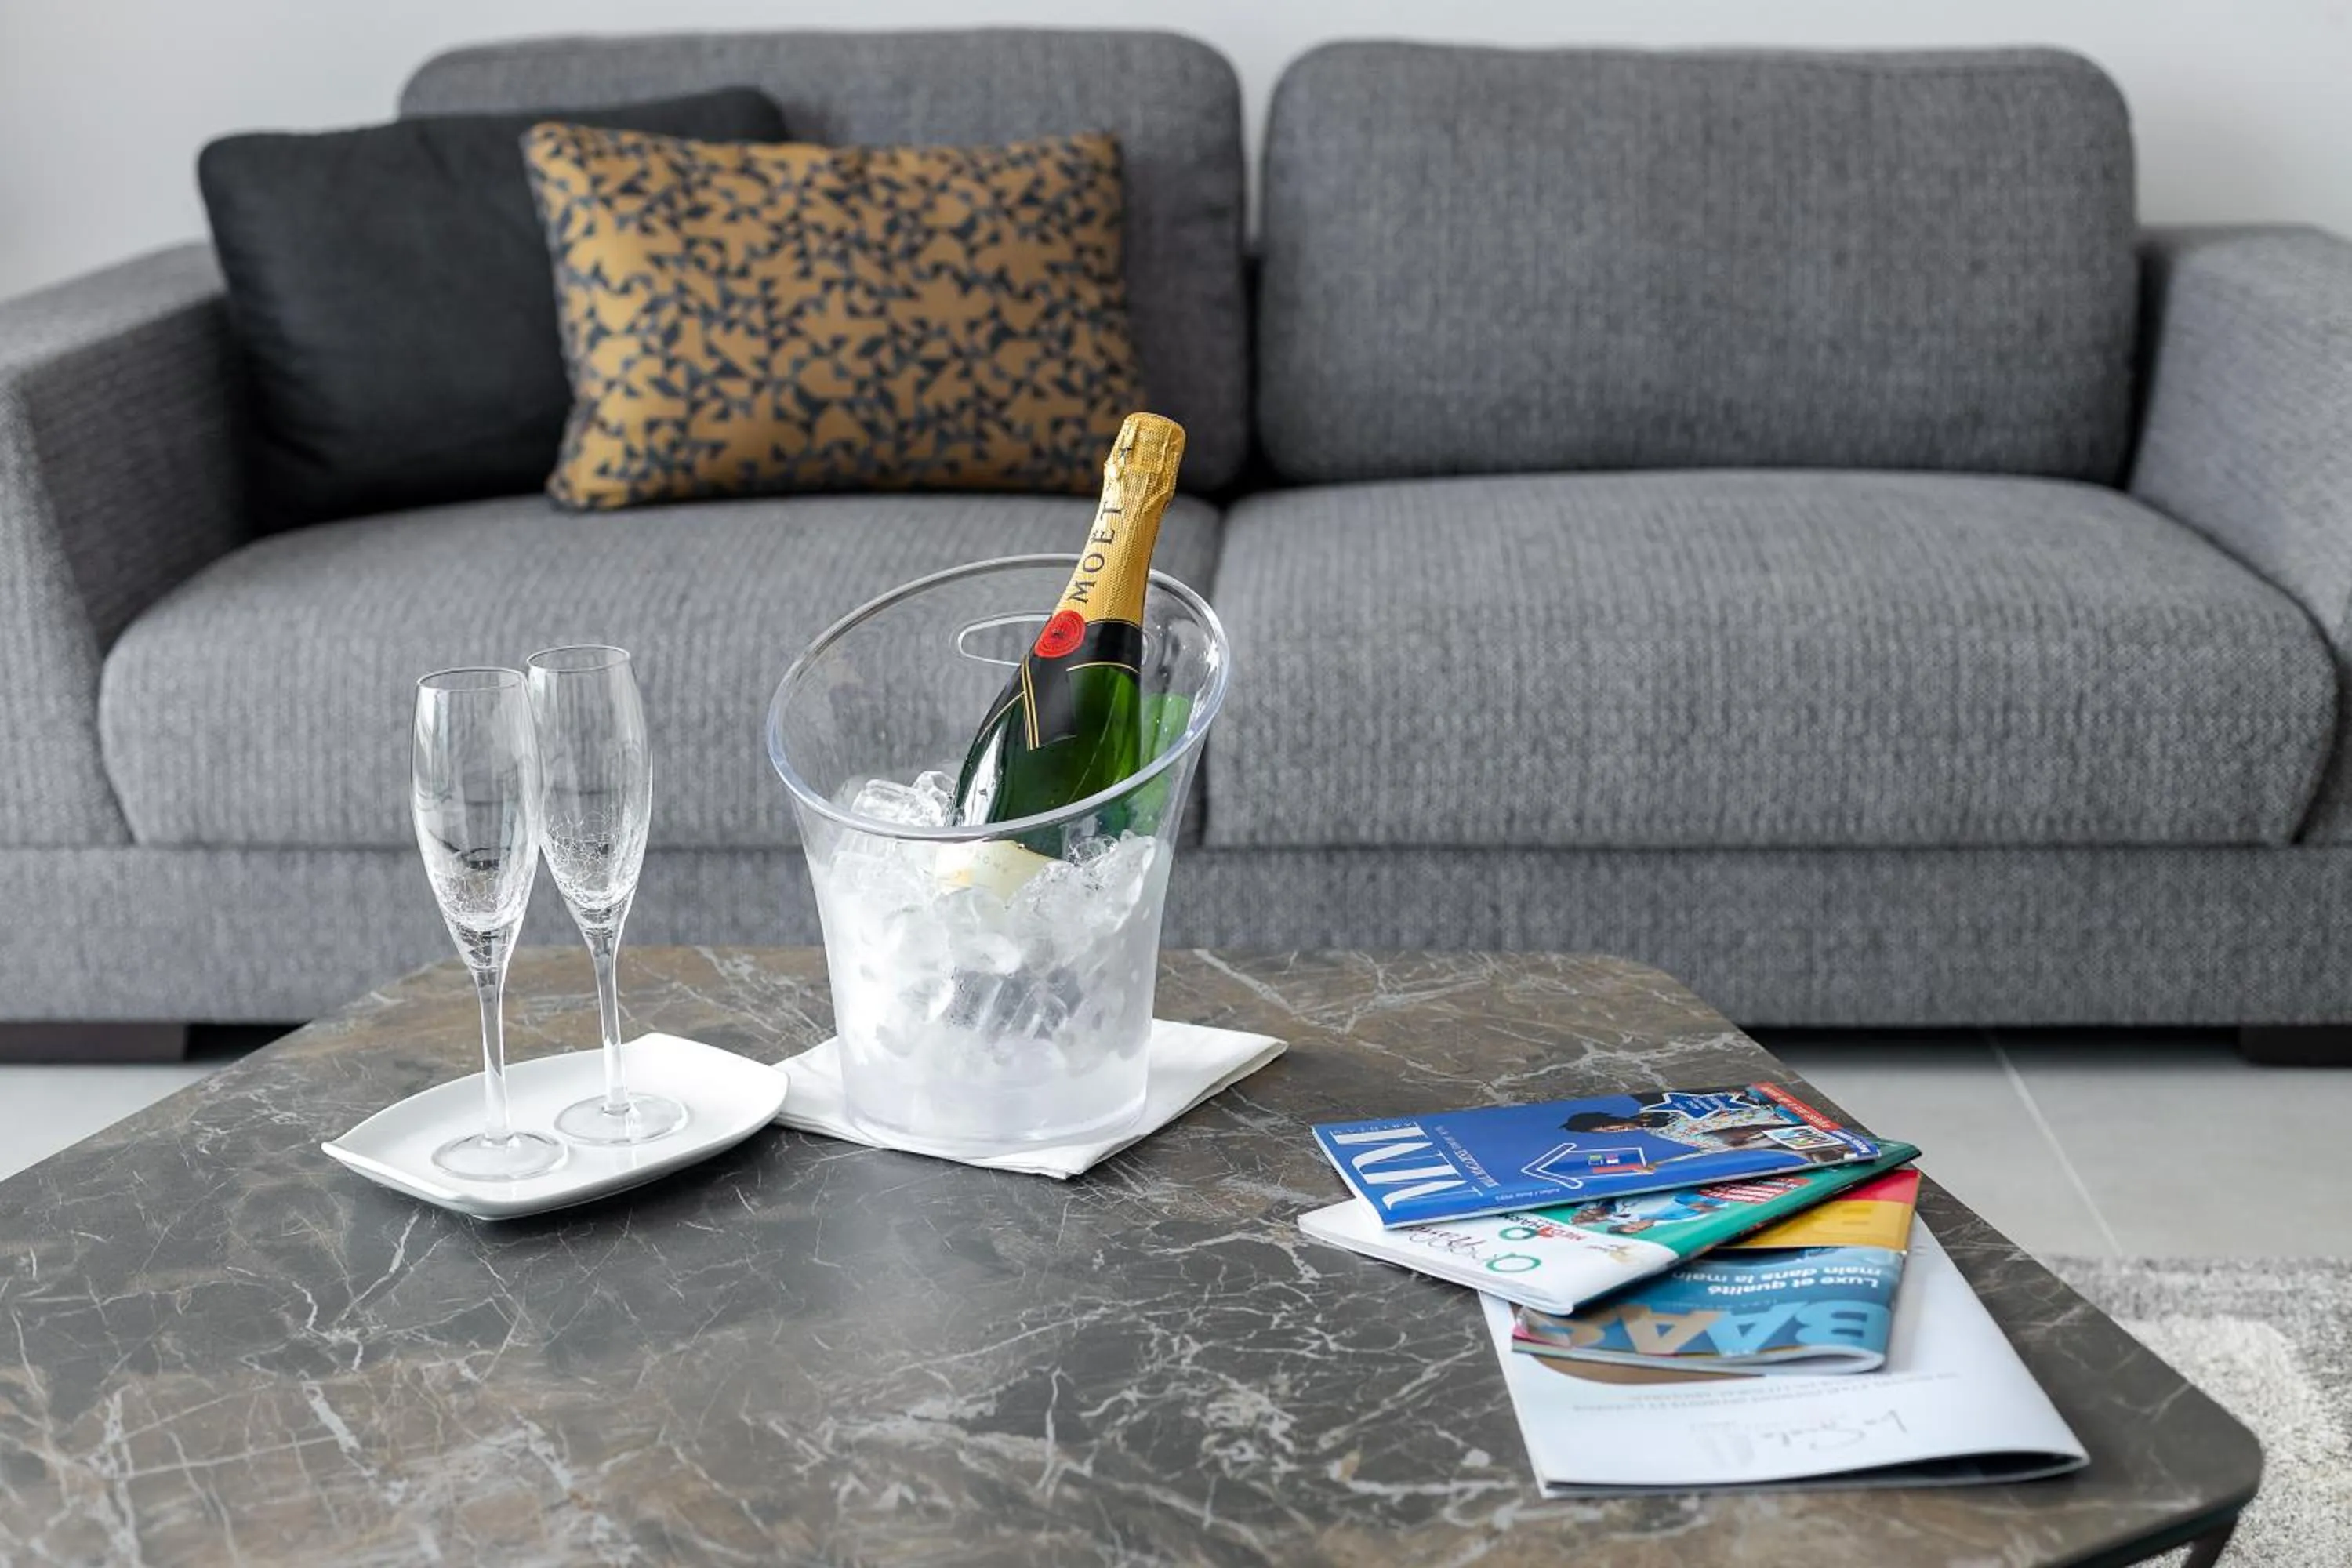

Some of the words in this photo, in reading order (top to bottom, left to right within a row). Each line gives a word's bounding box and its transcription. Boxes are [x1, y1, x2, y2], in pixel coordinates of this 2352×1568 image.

[1329, 1121, 1483, 1211] MM
[1671, 1270, 1729, 1284] main
[1760, 1267, 1818, 1282] dans
[1822, 1265, 1882, 1276] main
[1733, 1274, 1755, 1284] la
[1791, 1277, 1817, 1288] et
[1820, 1276, 1879, 1289] Luxe
[1707, 1279, 1788, 1296] qualité
